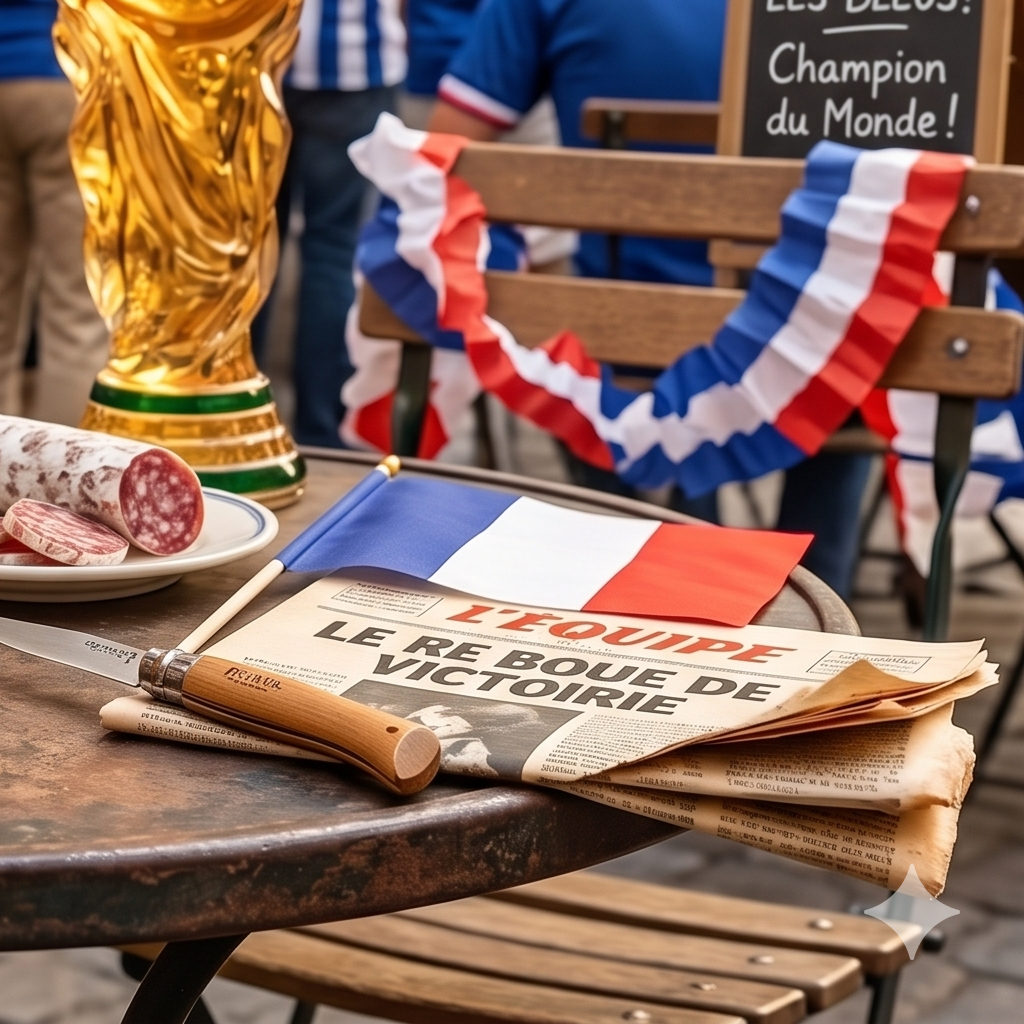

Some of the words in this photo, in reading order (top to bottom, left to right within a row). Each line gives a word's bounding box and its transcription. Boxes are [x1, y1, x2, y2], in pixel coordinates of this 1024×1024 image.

[768, 41, 947, 100] Champion
[766, 96, 810, 136] du
[312, 620, 397, 648] LE
[402, 635, 493, 663] RE
[493, 649, 678, 689] BOUE
[684, 675, 781, 702] DE
[372, 653, 688, 715] VICTOIRIE
